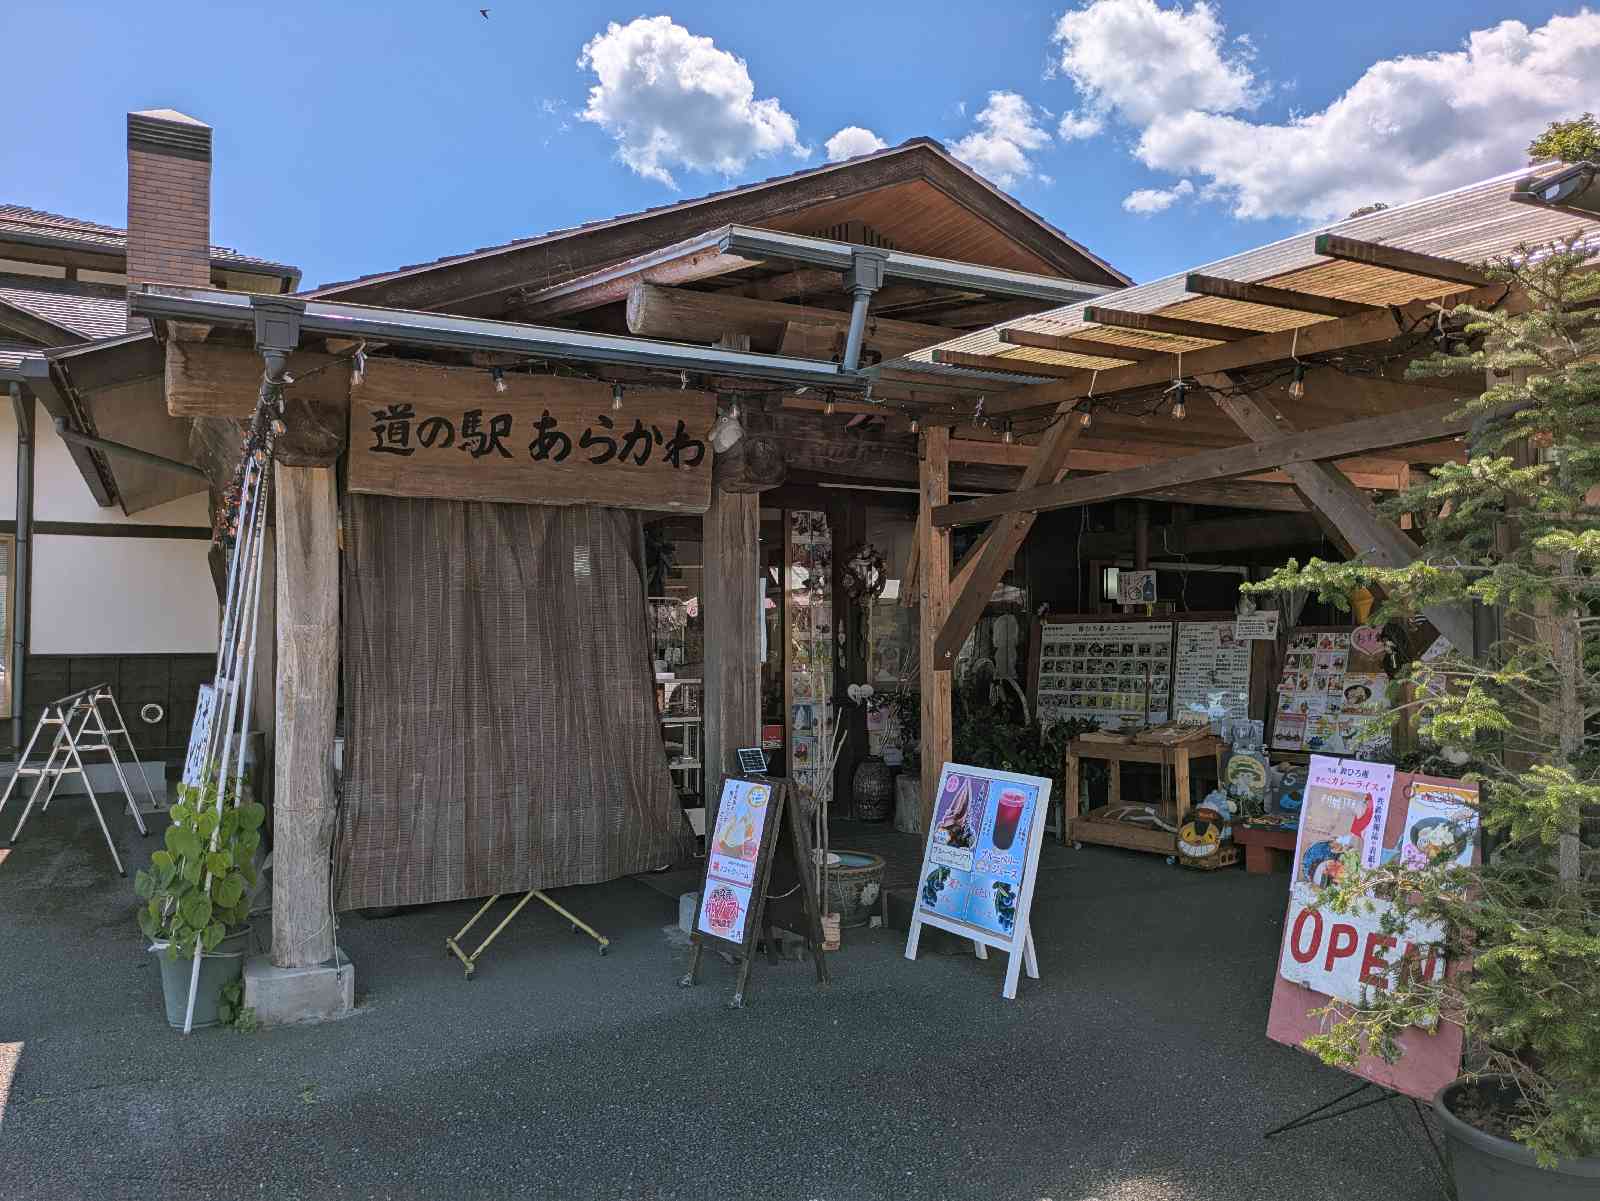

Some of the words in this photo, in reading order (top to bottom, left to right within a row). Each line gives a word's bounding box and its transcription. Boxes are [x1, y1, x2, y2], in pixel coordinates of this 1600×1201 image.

[369, 403, 513, 459] 道の駅
[529, 409, 706, 469] あらかわ
